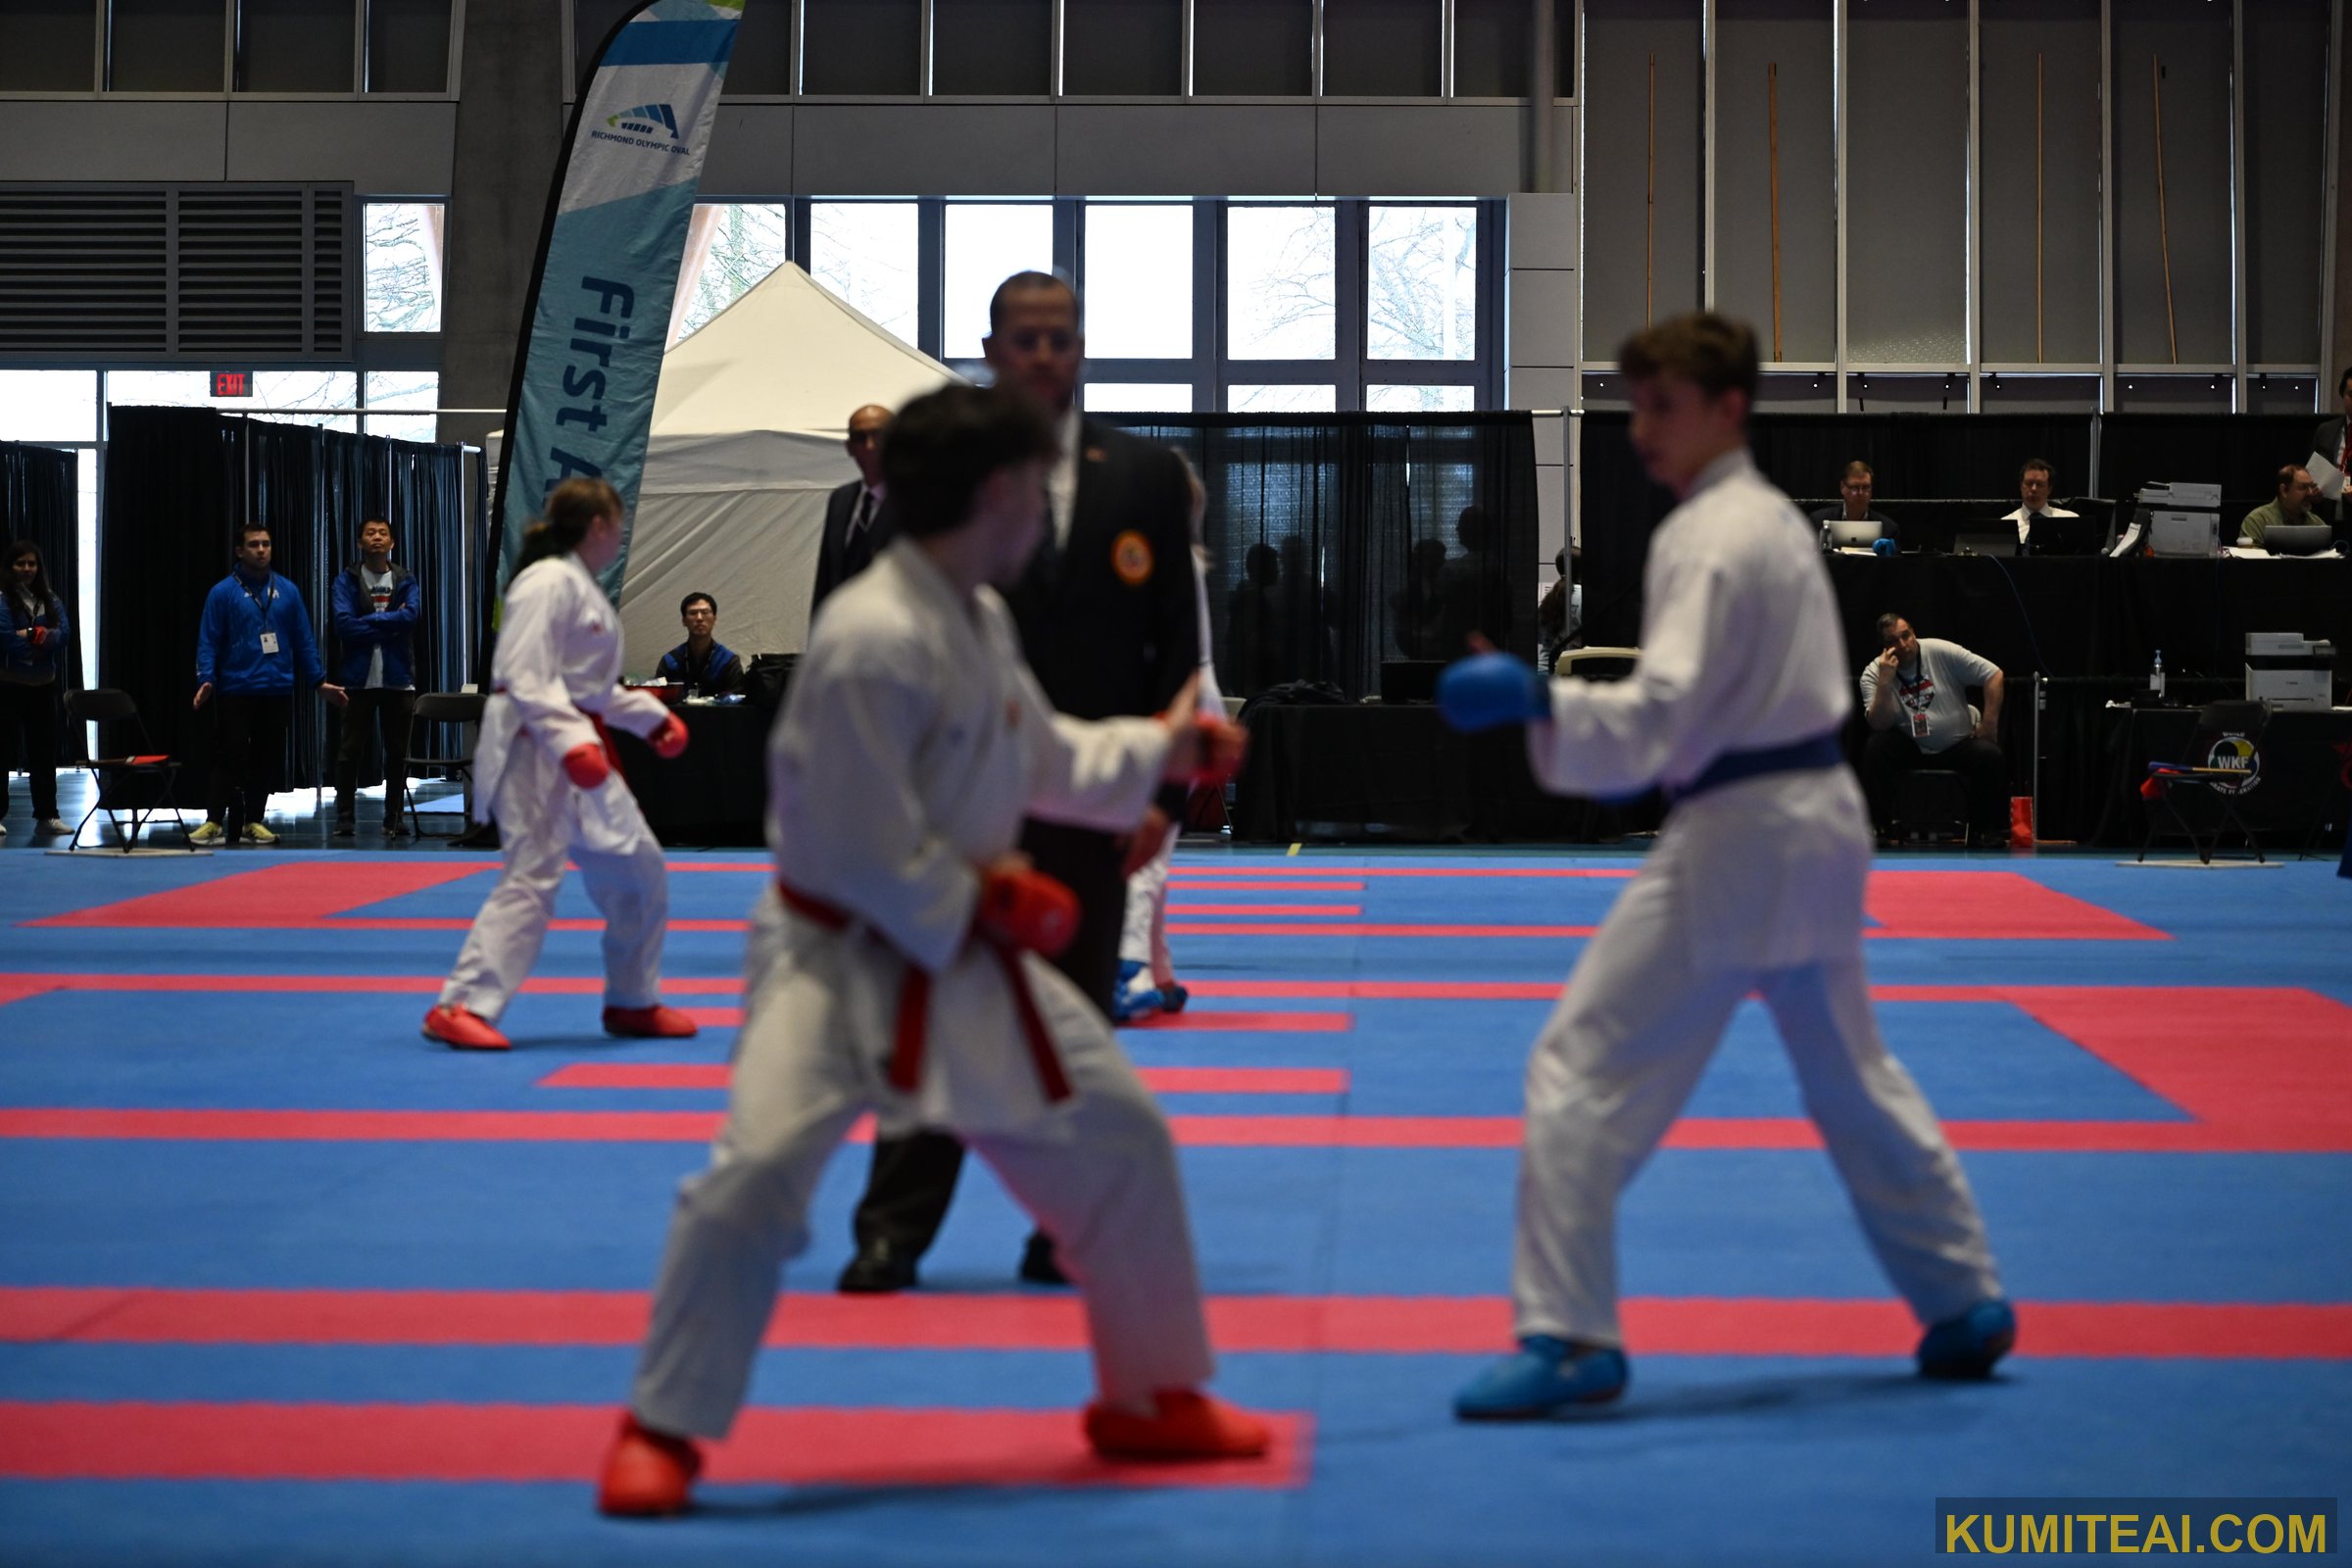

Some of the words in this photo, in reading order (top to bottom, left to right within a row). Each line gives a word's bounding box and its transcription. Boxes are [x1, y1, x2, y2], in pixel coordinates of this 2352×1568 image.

[591, 130, 634, 145] RICHMOND
[636, 139, 669, 152] OLYMPIC
[671, 146, 690, 156] OVAL
[556, 276, 635, 433] First
[217, 373, 245, 396] EXIT
[2218, 757, 2249, 769] WKF
